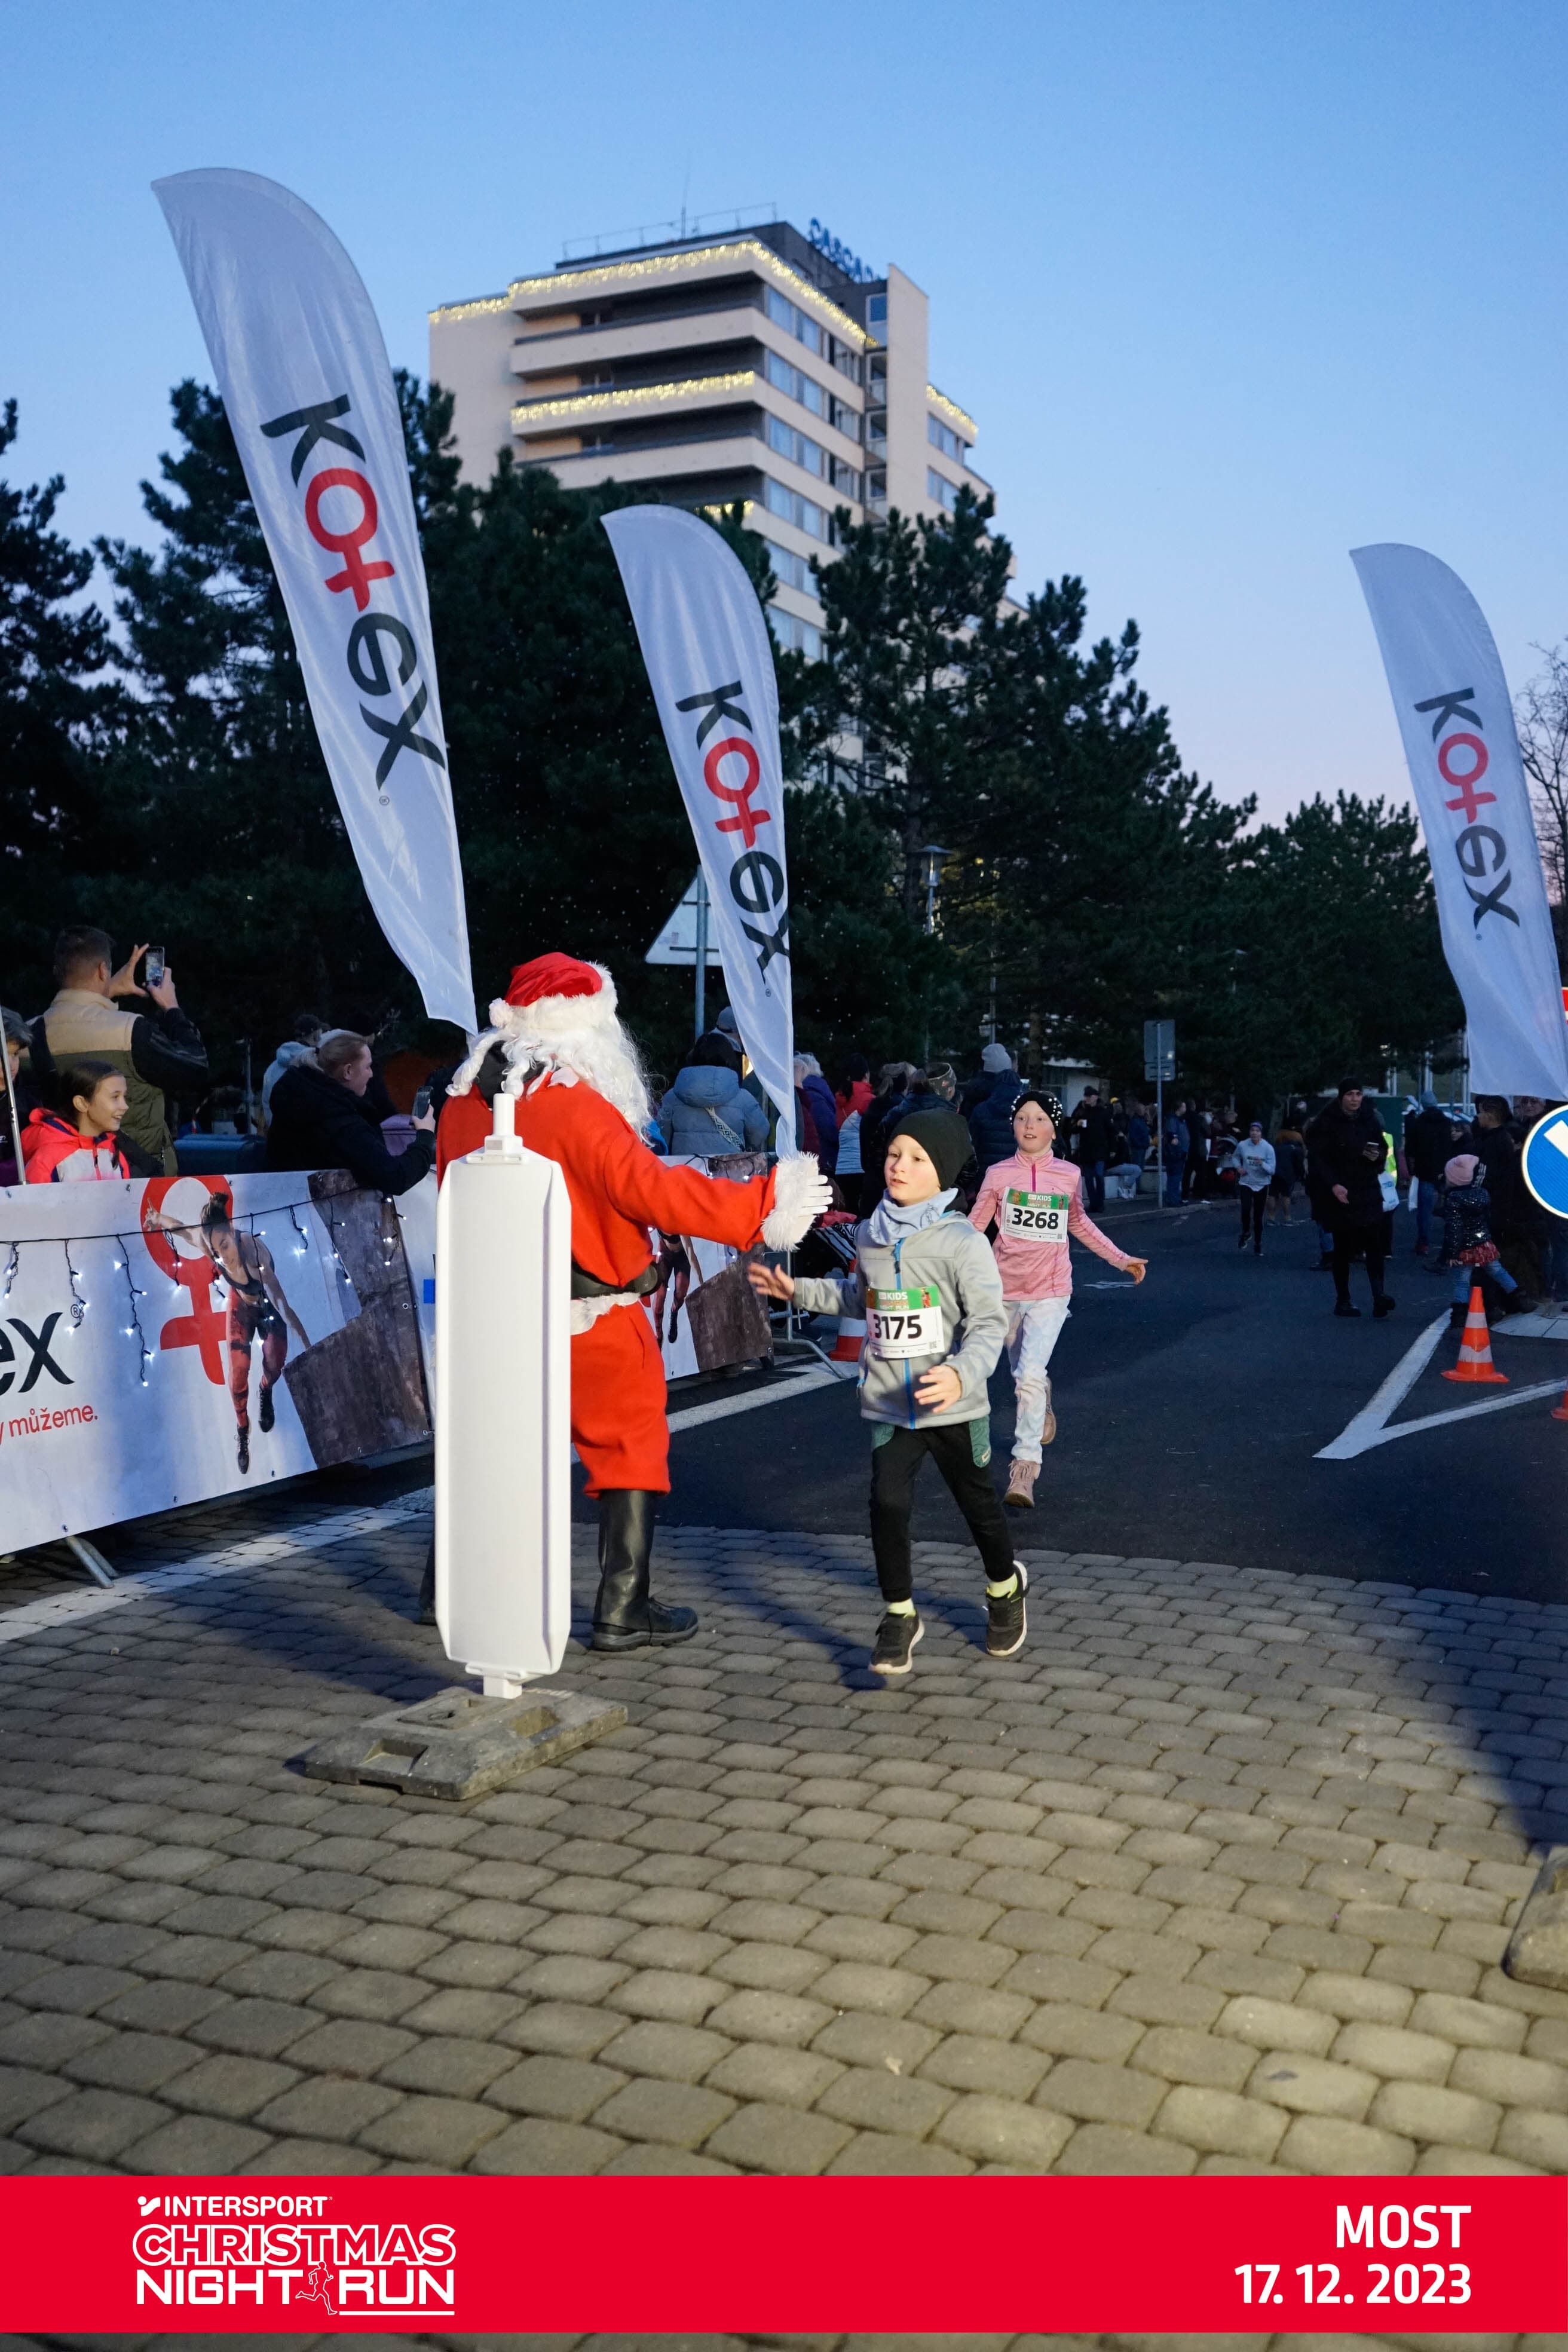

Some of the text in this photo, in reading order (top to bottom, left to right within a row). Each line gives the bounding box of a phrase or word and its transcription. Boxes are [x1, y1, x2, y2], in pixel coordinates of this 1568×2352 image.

[1012, 1208, 1059, 1230] 3268
[887, 1292, 908, 1300] KIDS
[873, 1314, 922, 1340] 3175
[8, 1405, 98, 1437] můžeme.
